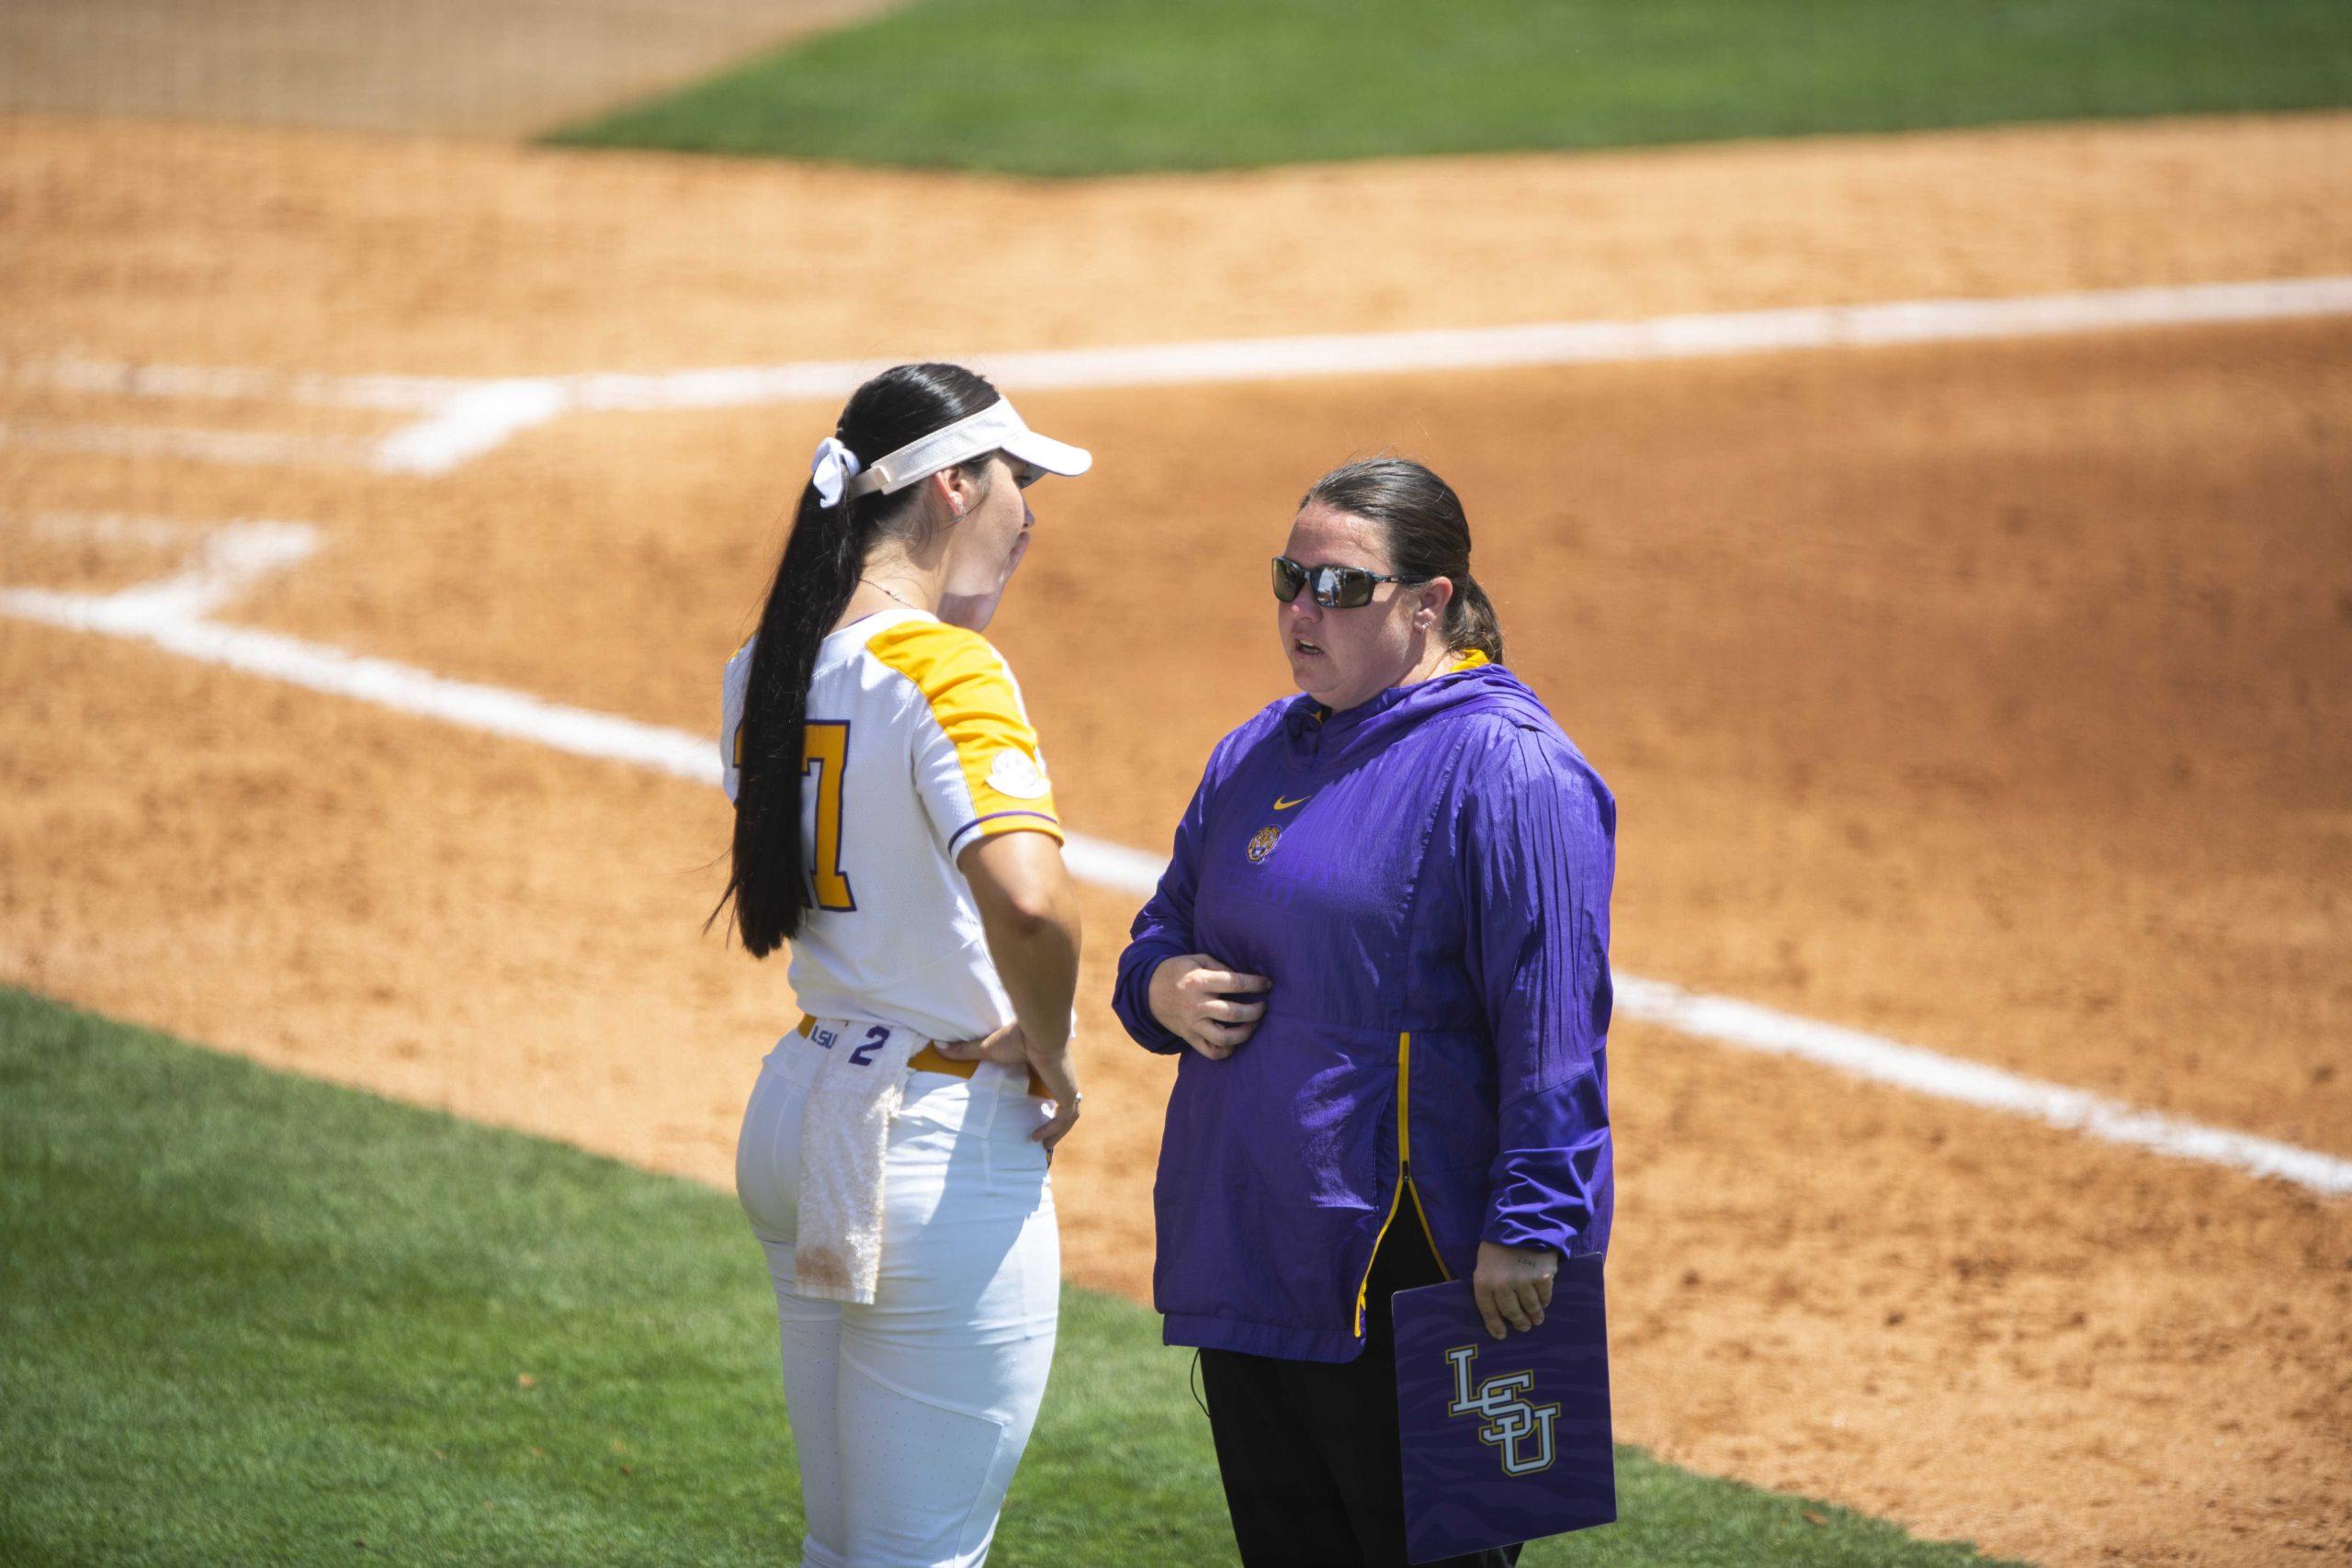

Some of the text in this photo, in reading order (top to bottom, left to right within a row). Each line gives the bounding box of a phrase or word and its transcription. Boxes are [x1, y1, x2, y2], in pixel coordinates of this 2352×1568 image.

[733, 719, 857, 912] 7
[810, 1025, 838, 1050] LSU
[848, 1025, 890, 1066] 2
[1444, 1343, 1561, 1477] LSU
